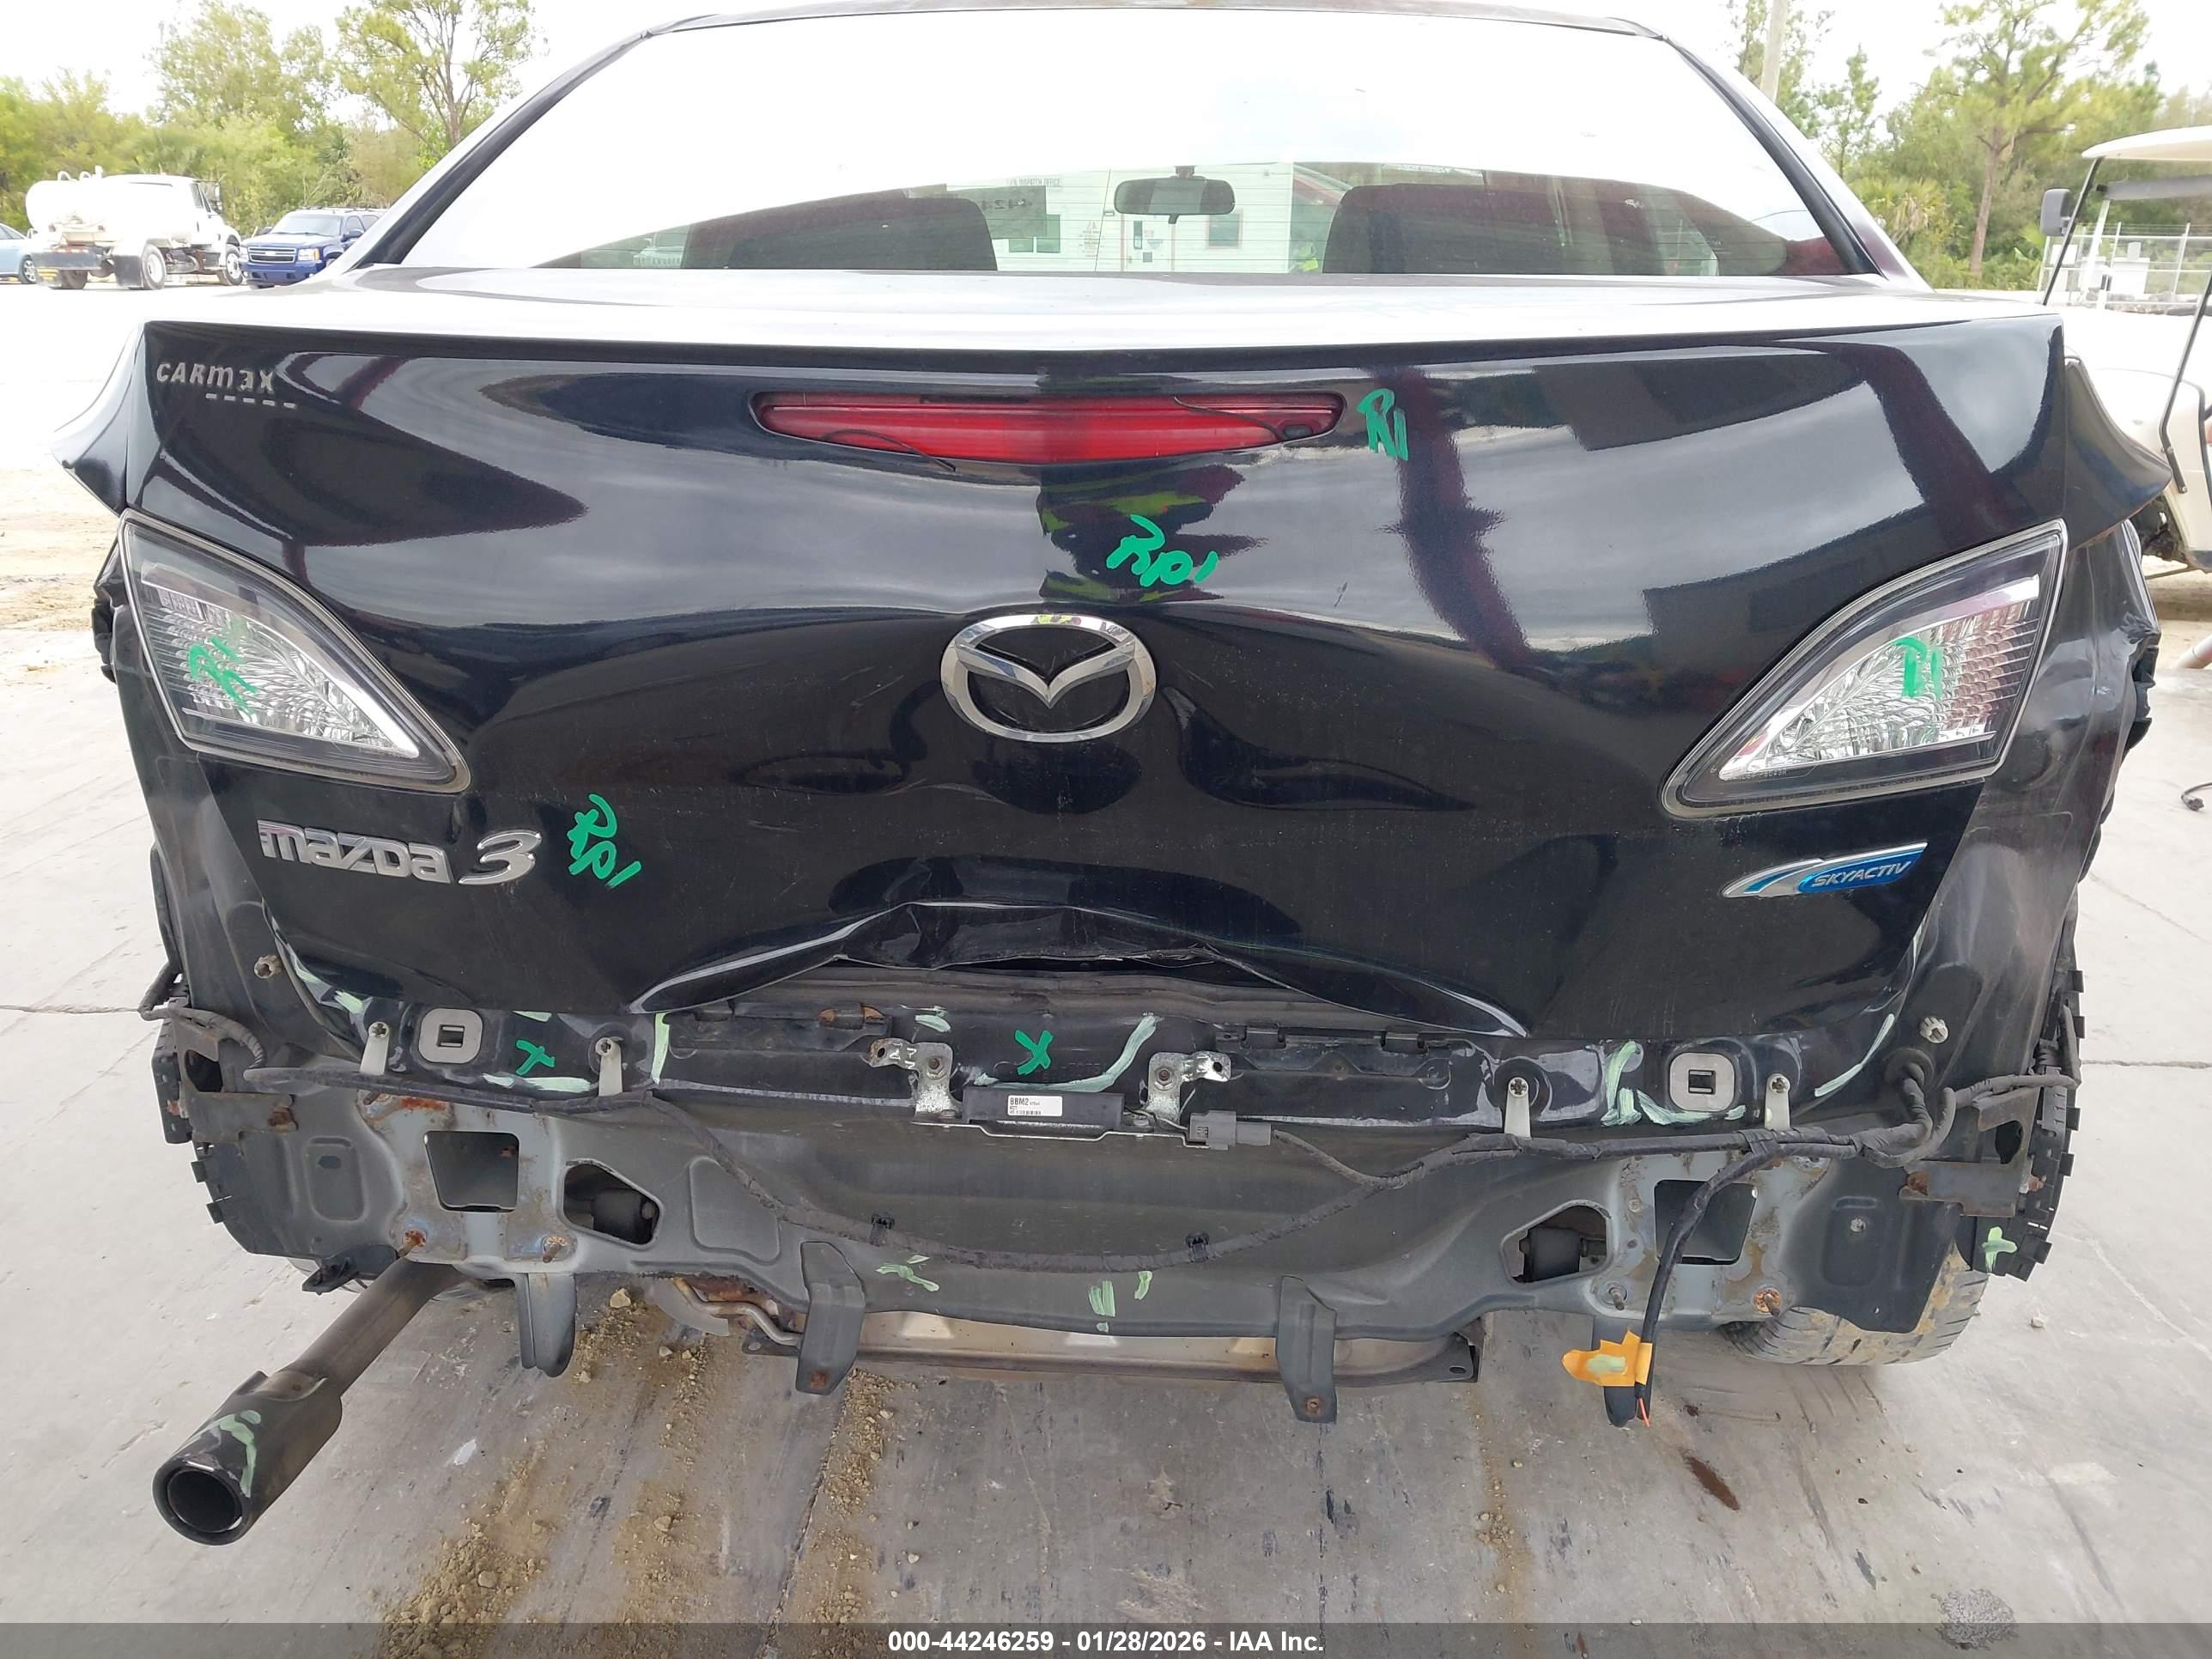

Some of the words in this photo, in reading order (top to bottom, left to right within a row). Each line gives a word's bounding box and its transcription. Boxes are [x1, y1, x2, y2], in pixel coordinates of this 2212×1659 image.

[457, 829, 543, 885] 3
[1811, 860, 1911, 888] SKYACTIV
[1010, 1097, 1030, 1106] BBM2
